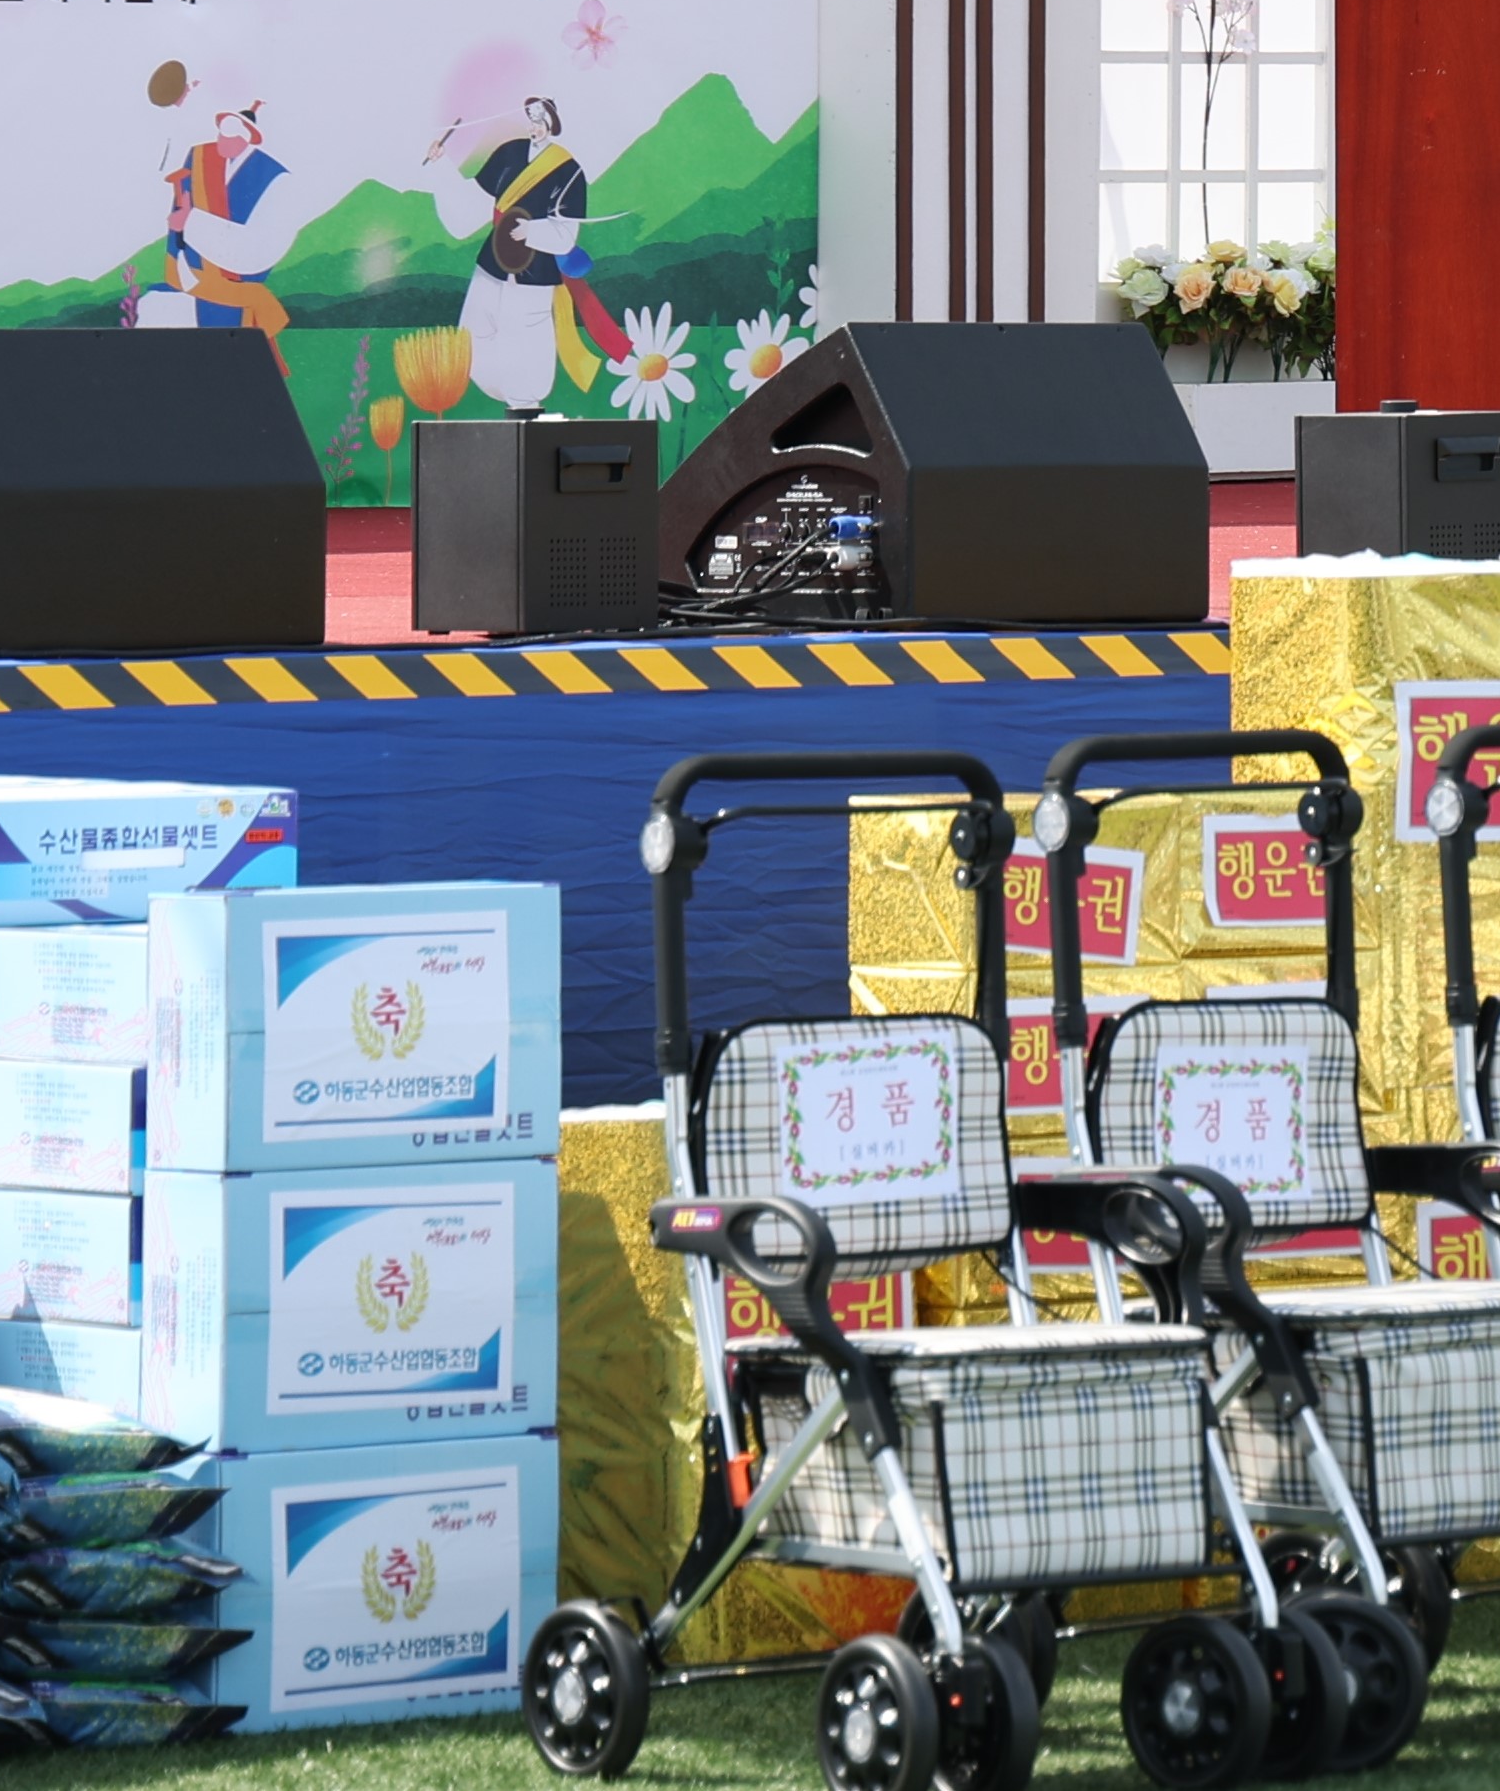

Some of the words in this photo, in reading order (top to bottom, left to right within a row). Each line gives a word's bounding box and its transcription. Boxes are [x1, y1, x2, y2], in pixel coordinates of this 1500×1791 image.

[38, 824, 218, 857] 수산물종합선물셋트
[1004, 862, 1125, 936] 행권
[370, 987, 406, 1037] 축
[324, 1074, 473, 1102] 하동군수산업협동조합
[375, 1258, 410, 1309] 축
[328, 1347, 478, 1375] 하동군수산업협동조합
[381, 1547, 417, 1597] 축
[335, 1631, 486, 1667] 하동군수산업협동조합
